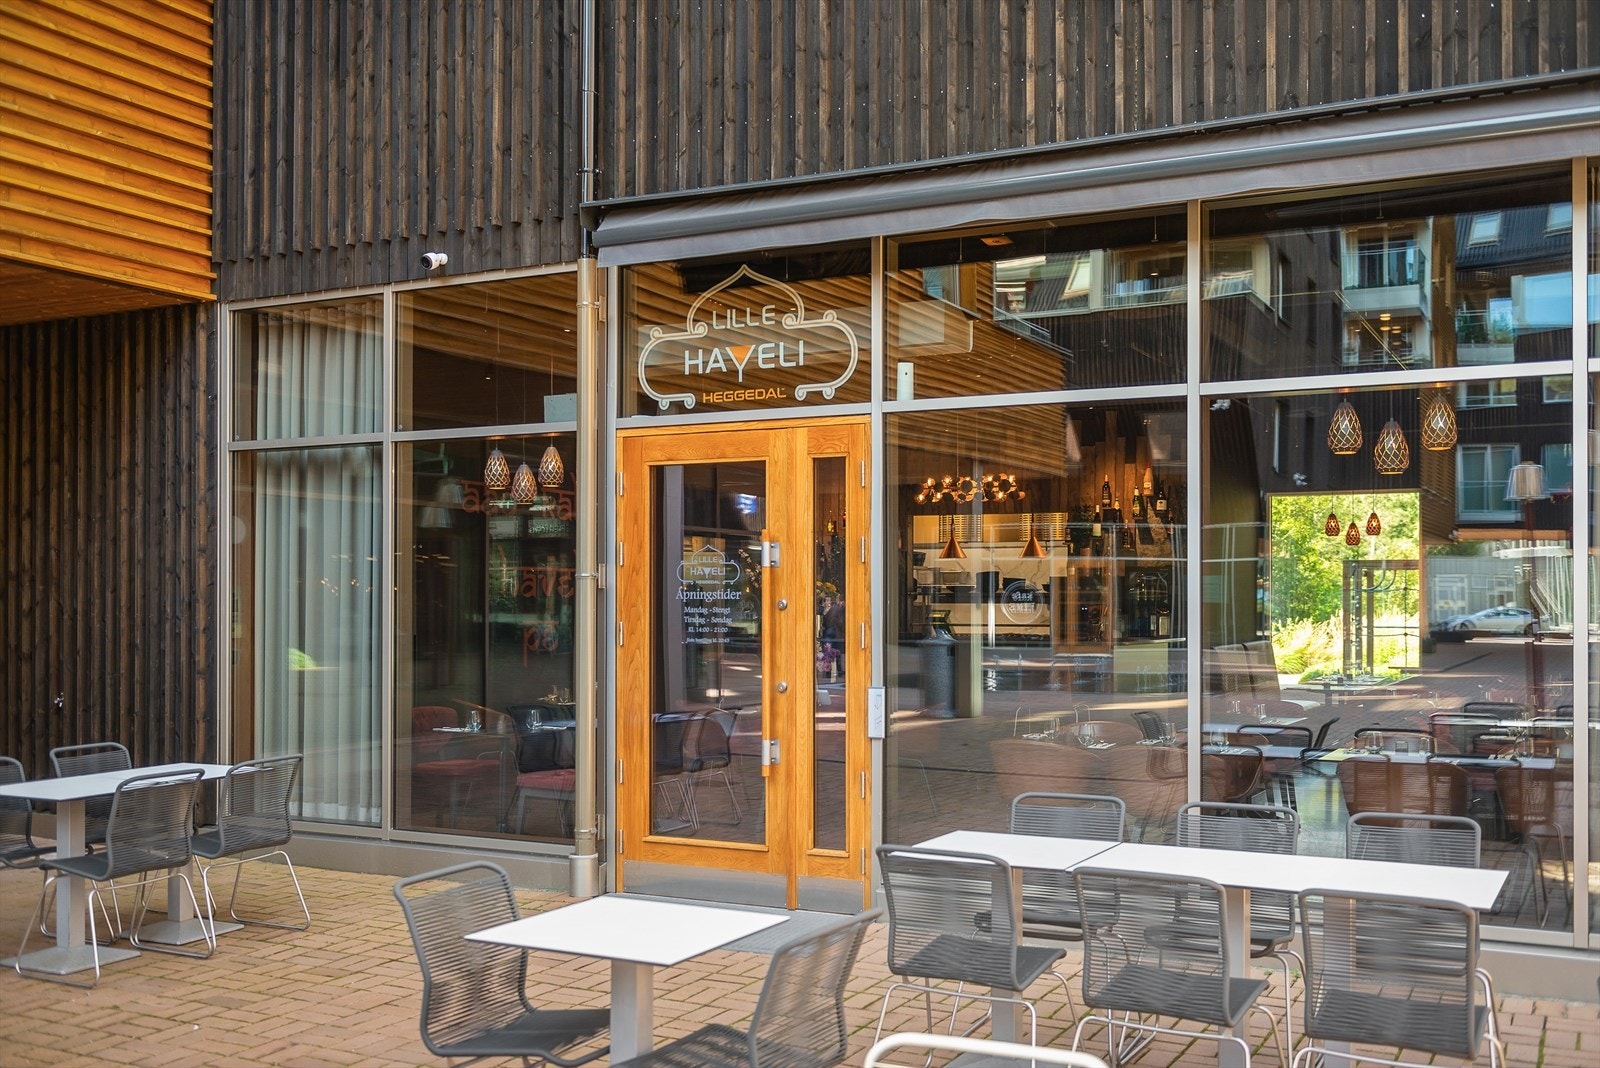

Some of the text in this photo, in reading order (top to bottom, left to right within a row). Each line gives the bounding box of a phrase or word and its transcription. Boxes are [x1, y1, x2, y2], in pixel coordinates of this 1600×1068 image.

[712, 304, 776, 330] LILLE
[702, 387, 787, 403] HEGGEDAL
[684, 606, 708, 615] Mandag
[684, 616, 705, 624] Tirsdag
